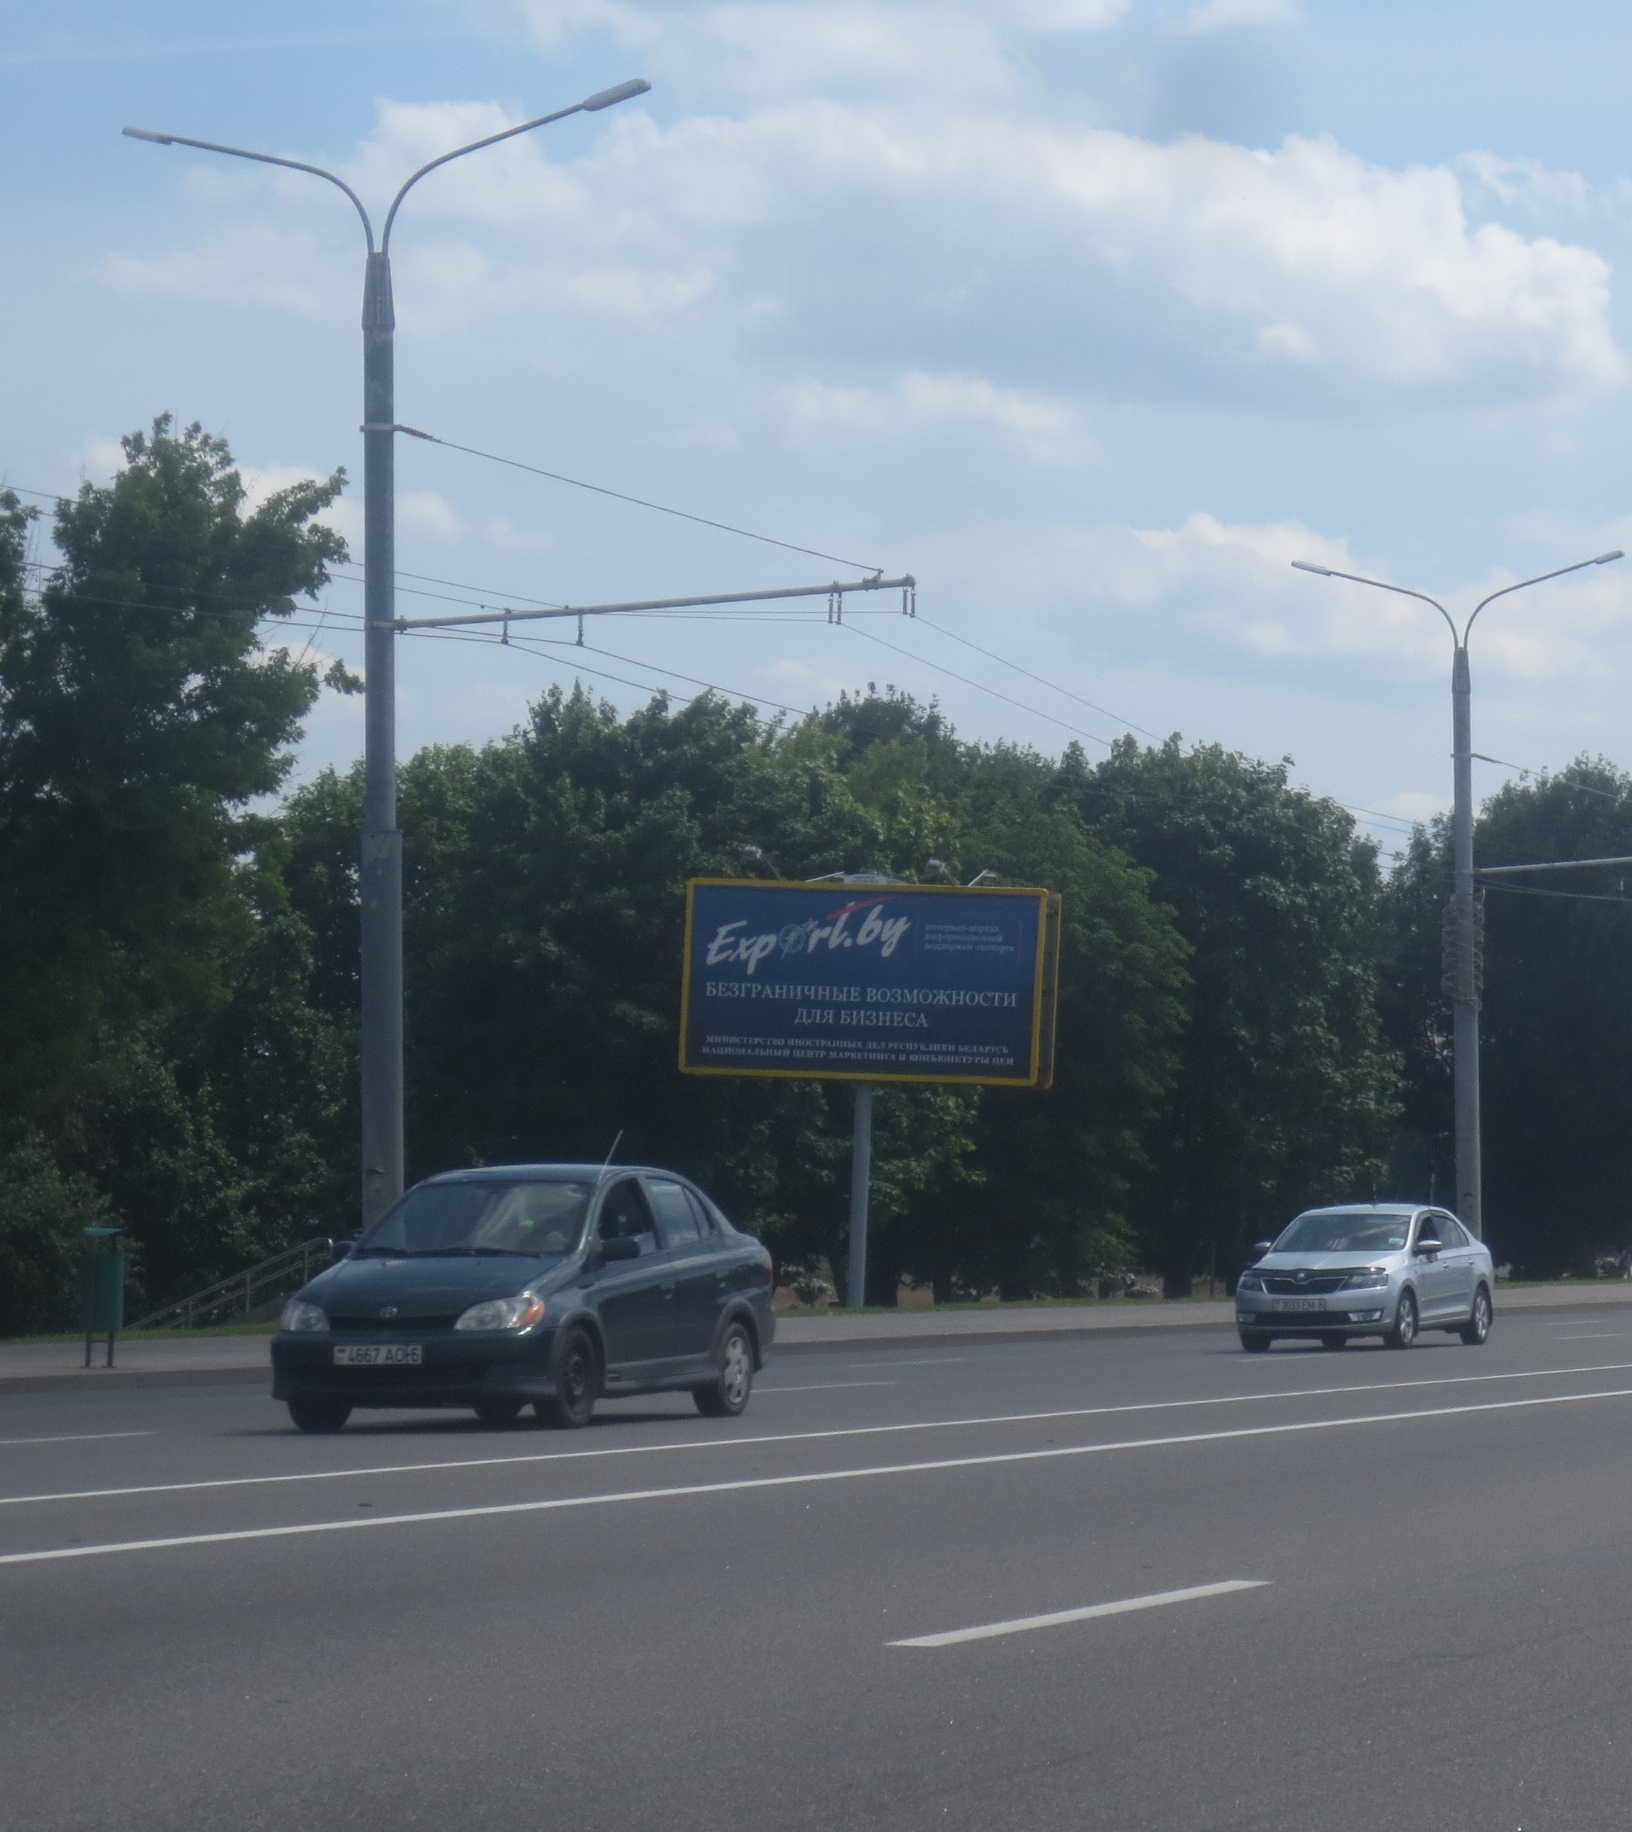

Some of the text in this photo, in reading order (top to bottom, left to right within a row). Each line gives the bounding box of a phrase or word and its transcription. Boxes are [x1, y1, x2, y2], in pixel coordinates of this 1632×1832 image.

[706, 898, 911, 976] Export.by
[705, 981, 1017, 1008] БЕЗГРАНИЧНЫЕ ВОЗМОЖНОСТИ
[794, 1008, 929, 1028] ДЛЯ БИЗНЕСА
[705, 1035, 1009, 1054] МИНИСТЕРСТВО ИНОСТРАННЫХ ДЕЛ РЕСПУБЛИКИ БЕЛАРУСЬ
[702, 1046, 791, 1057] НАЦИОНАЛЬНЫЙ
[793, 1049, 826, 1059] ЦЕНТР
[828, 1051, 896, 1062] МАРКЕТИНГА
[909, 1054, 990, 1065] КОНЪЮНКТУРЫ
[992, 1056, 1015, 1067] ЦЕН
[348, 1346, 380, 1363] 4667
